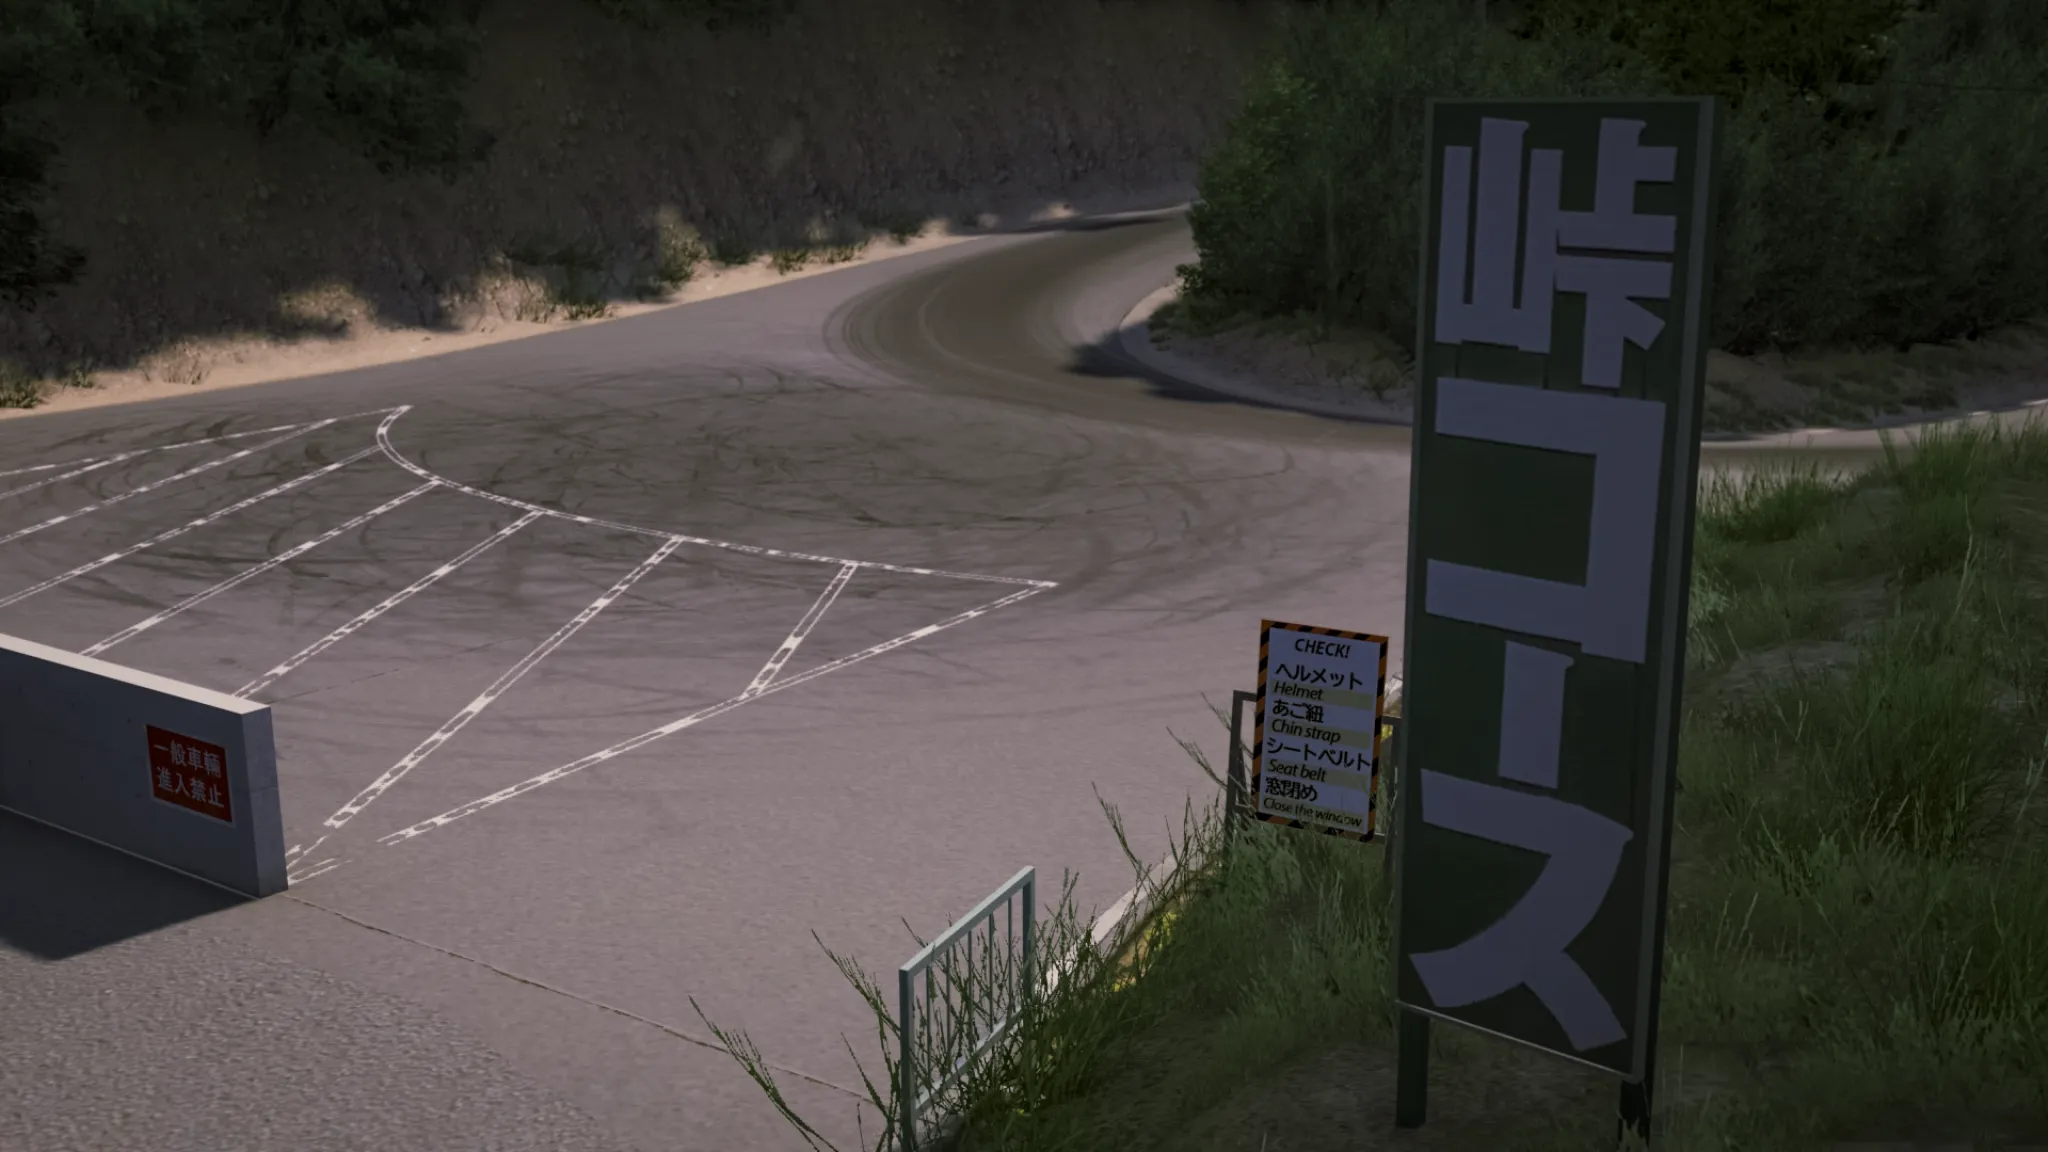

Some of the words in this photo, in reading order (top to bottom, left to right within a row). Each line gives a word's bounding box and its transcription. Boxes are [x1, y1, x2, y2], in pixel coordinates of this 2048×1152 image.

[1409, 117, 1677, 1052] 峠コース
[1295, 638, 1350, 659] CHECK!
[1275, 663, 1363, 690] ヘルメット
[1273, 681, 1324, 700] Helmet
[1272, 699, 1324, 724] あご紐
[1271, 718, 1303, 737] Chin
[1305, 727, 1341, 745] strap
[1266, 736, 1371, 771] シートベルト
[1267, 758, 1298, 776] Seat
[1300, 763, 1328, 782] belt
[156, 766, 225, 808] 進入禁止
[1265, 776, 1318, 802] 窓閉め
[1263, 797, 1293, 813] Close
[1295, 804, 1314, 818] the
